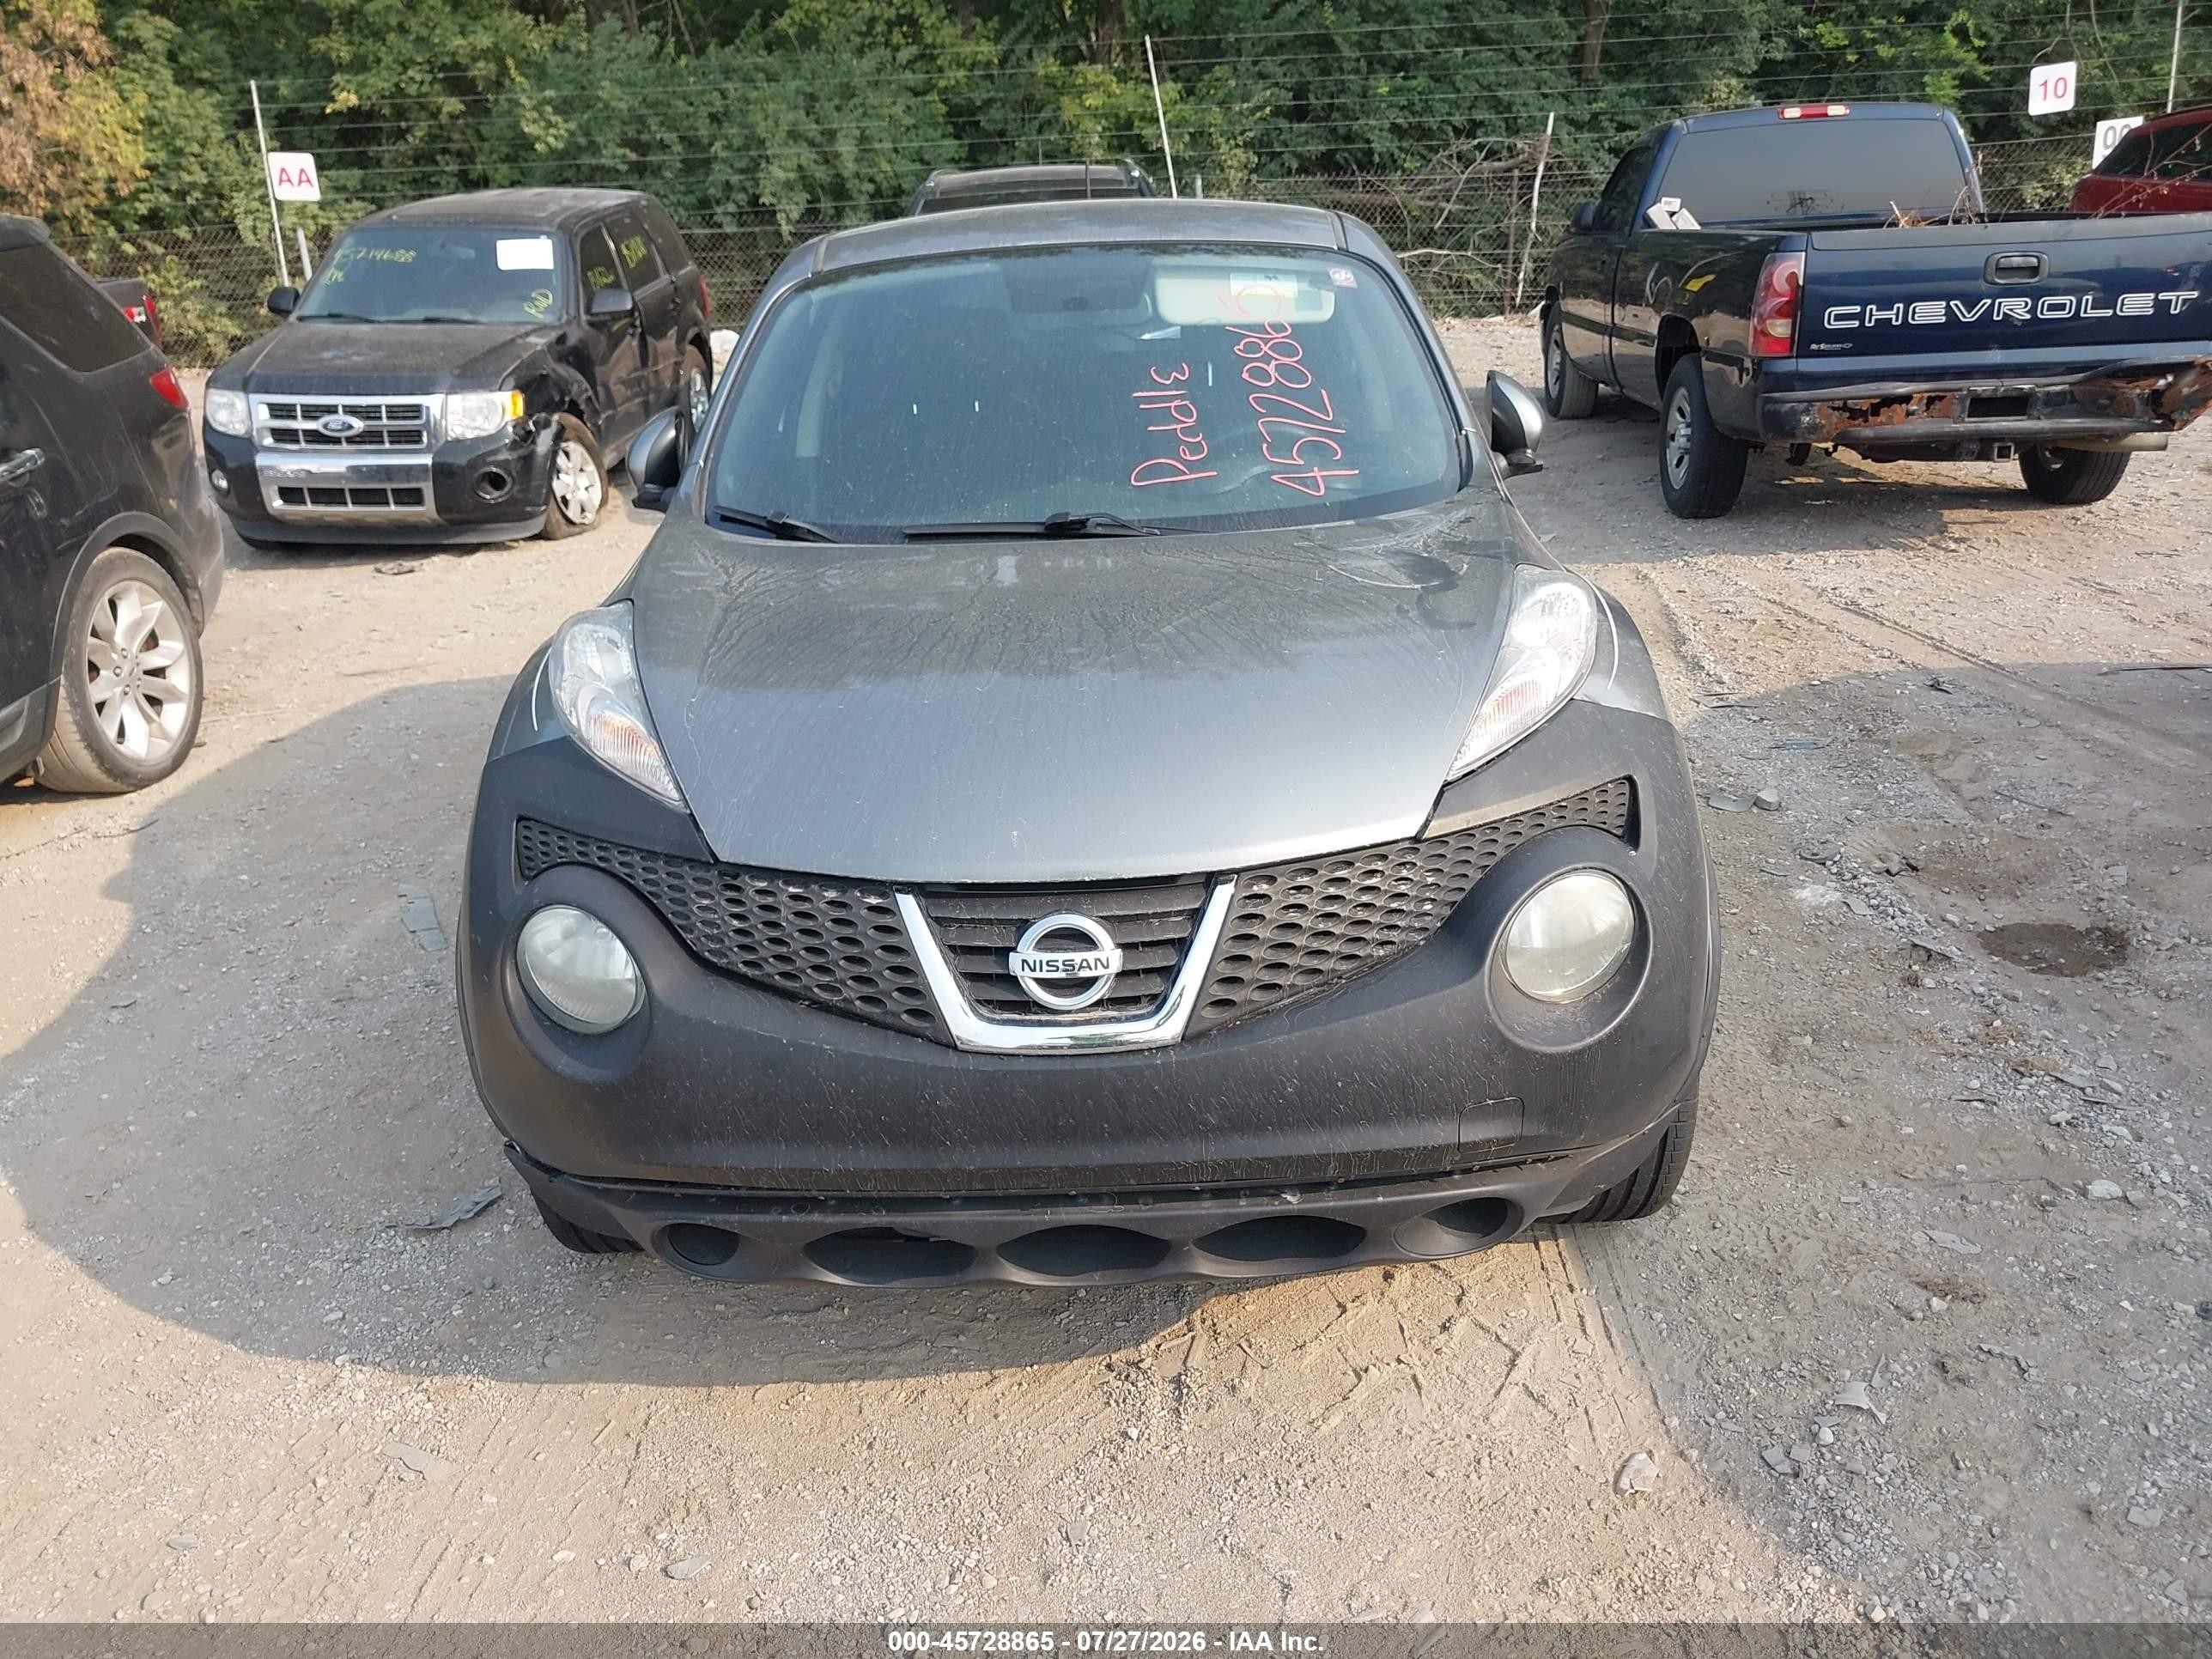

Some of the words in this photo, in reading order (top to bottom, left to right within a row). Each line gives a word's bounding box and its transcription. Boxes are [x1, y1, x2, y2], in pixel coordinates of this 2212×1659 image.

[2039, 76, 2068, 101] 10
[278, 167, 314, 187] AA
[1824, 290, 2200, 330] CHEVROLET
[1020, 957, 1110, 973] NISSAN
